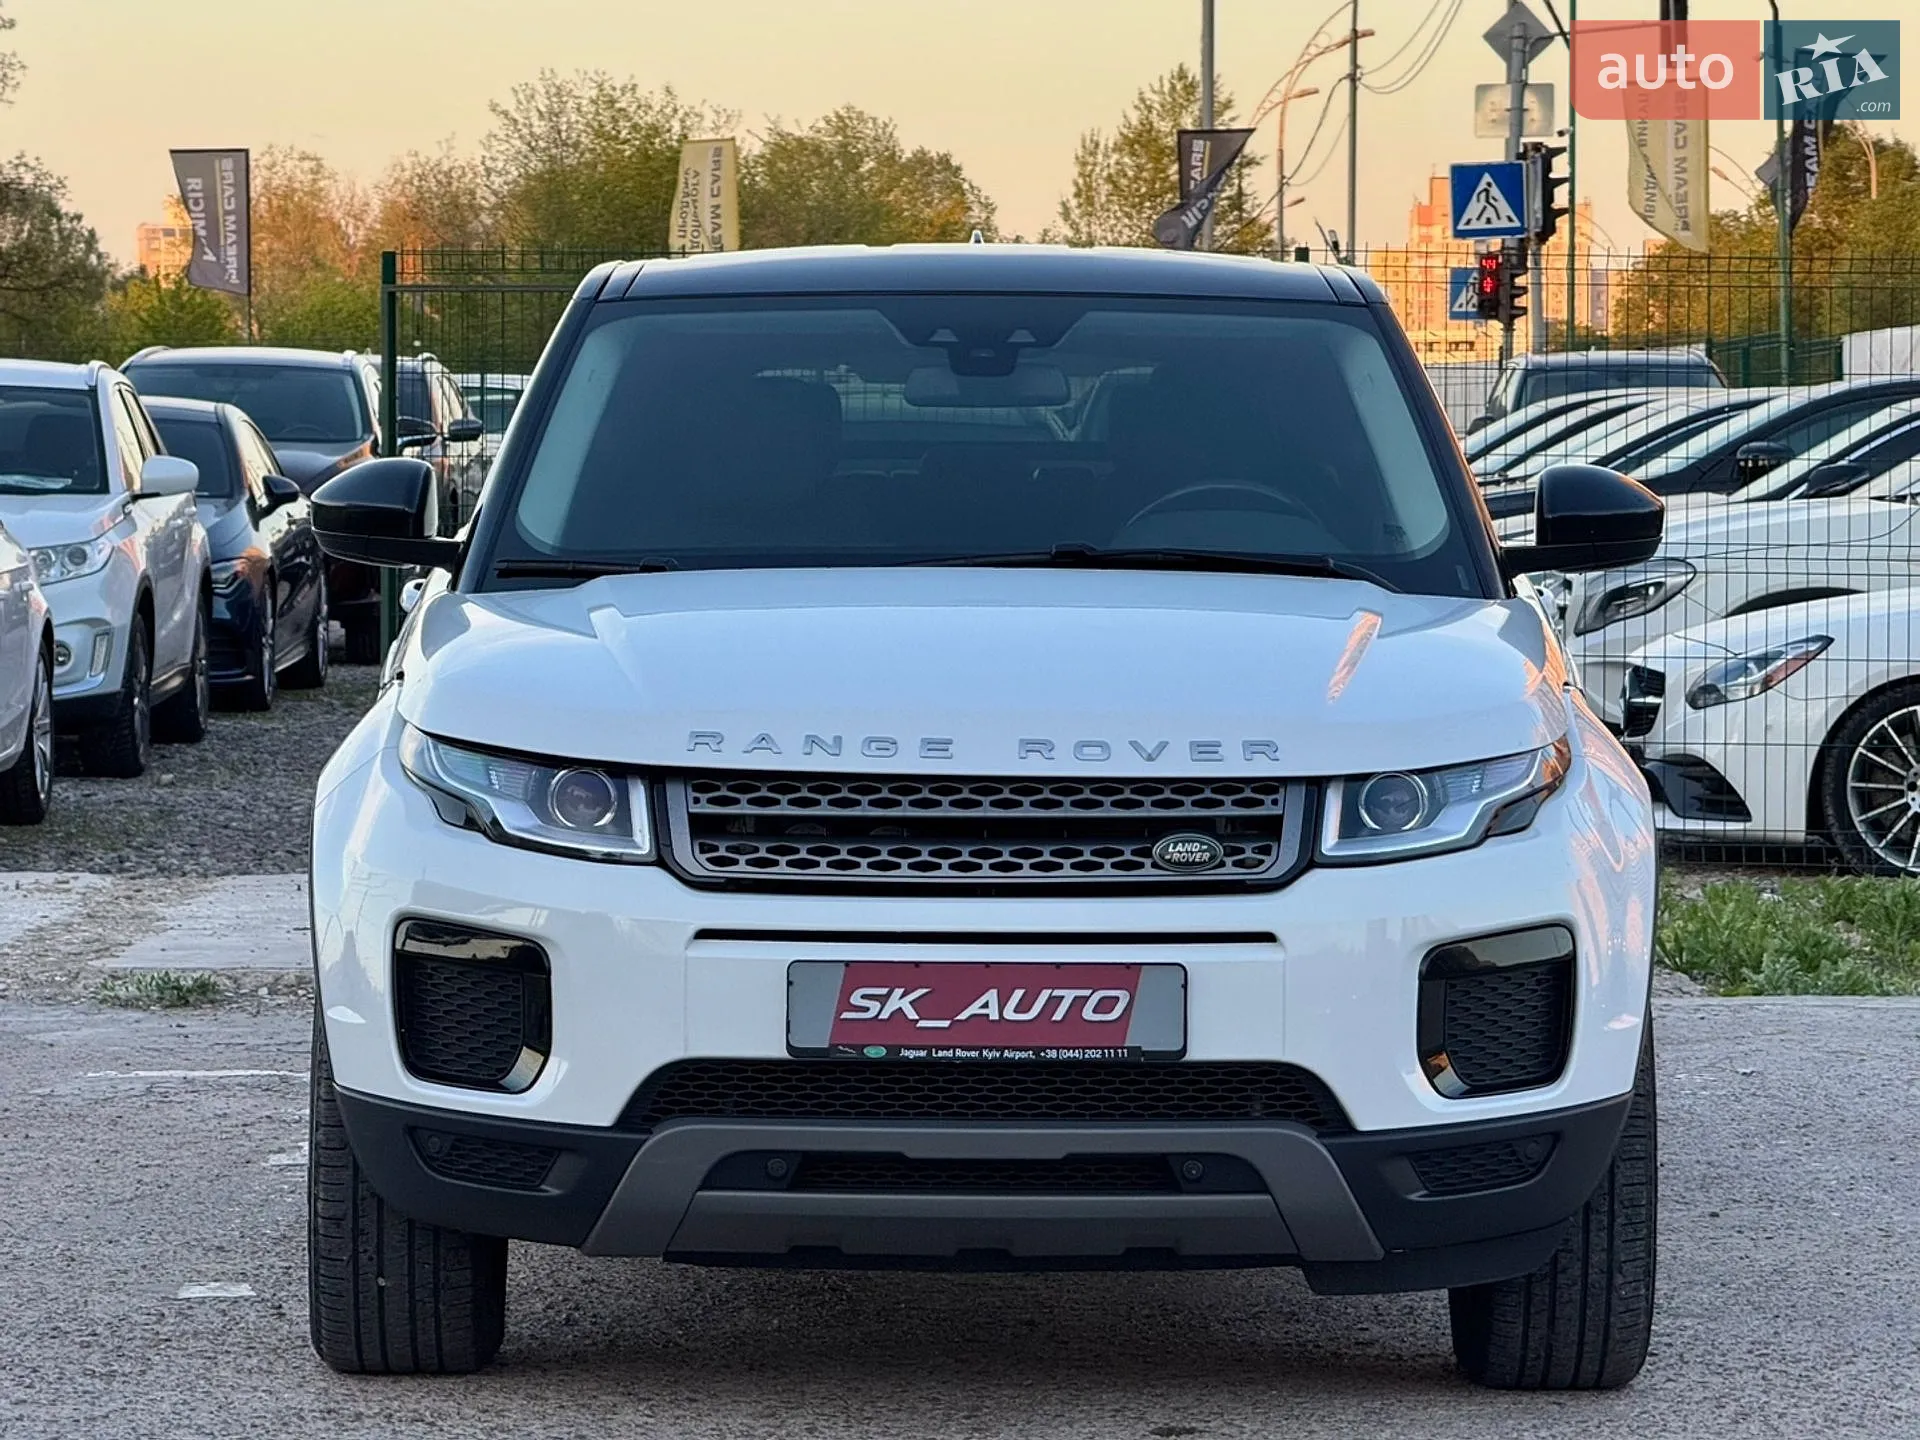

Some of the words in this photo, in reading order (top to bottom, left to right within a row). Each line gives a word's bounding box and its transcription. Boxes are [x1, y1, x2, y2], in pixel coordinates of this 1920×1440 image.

[686, 730, 954, 759] RANGE
[1018, 738, 1280, 762] ROVER
[839, 986, 1131, 1028] SK_AUTO
[899, 1047, 927, 1059] Jaguar
[932, 1048, 953, 1057] Land
[956, 1048, 979, 1058] Rover
[982, 1048, 1001, 1060] Kyiv
[1039, 1049, 1057, 1058] +38
[1058, 1048, 1083, 1060] (044)
[1084, 1049, 1102, 1058] 202
[1104, 1049, 1115, 1058] 11
[1116, 1049, 1128, 1058] 11
